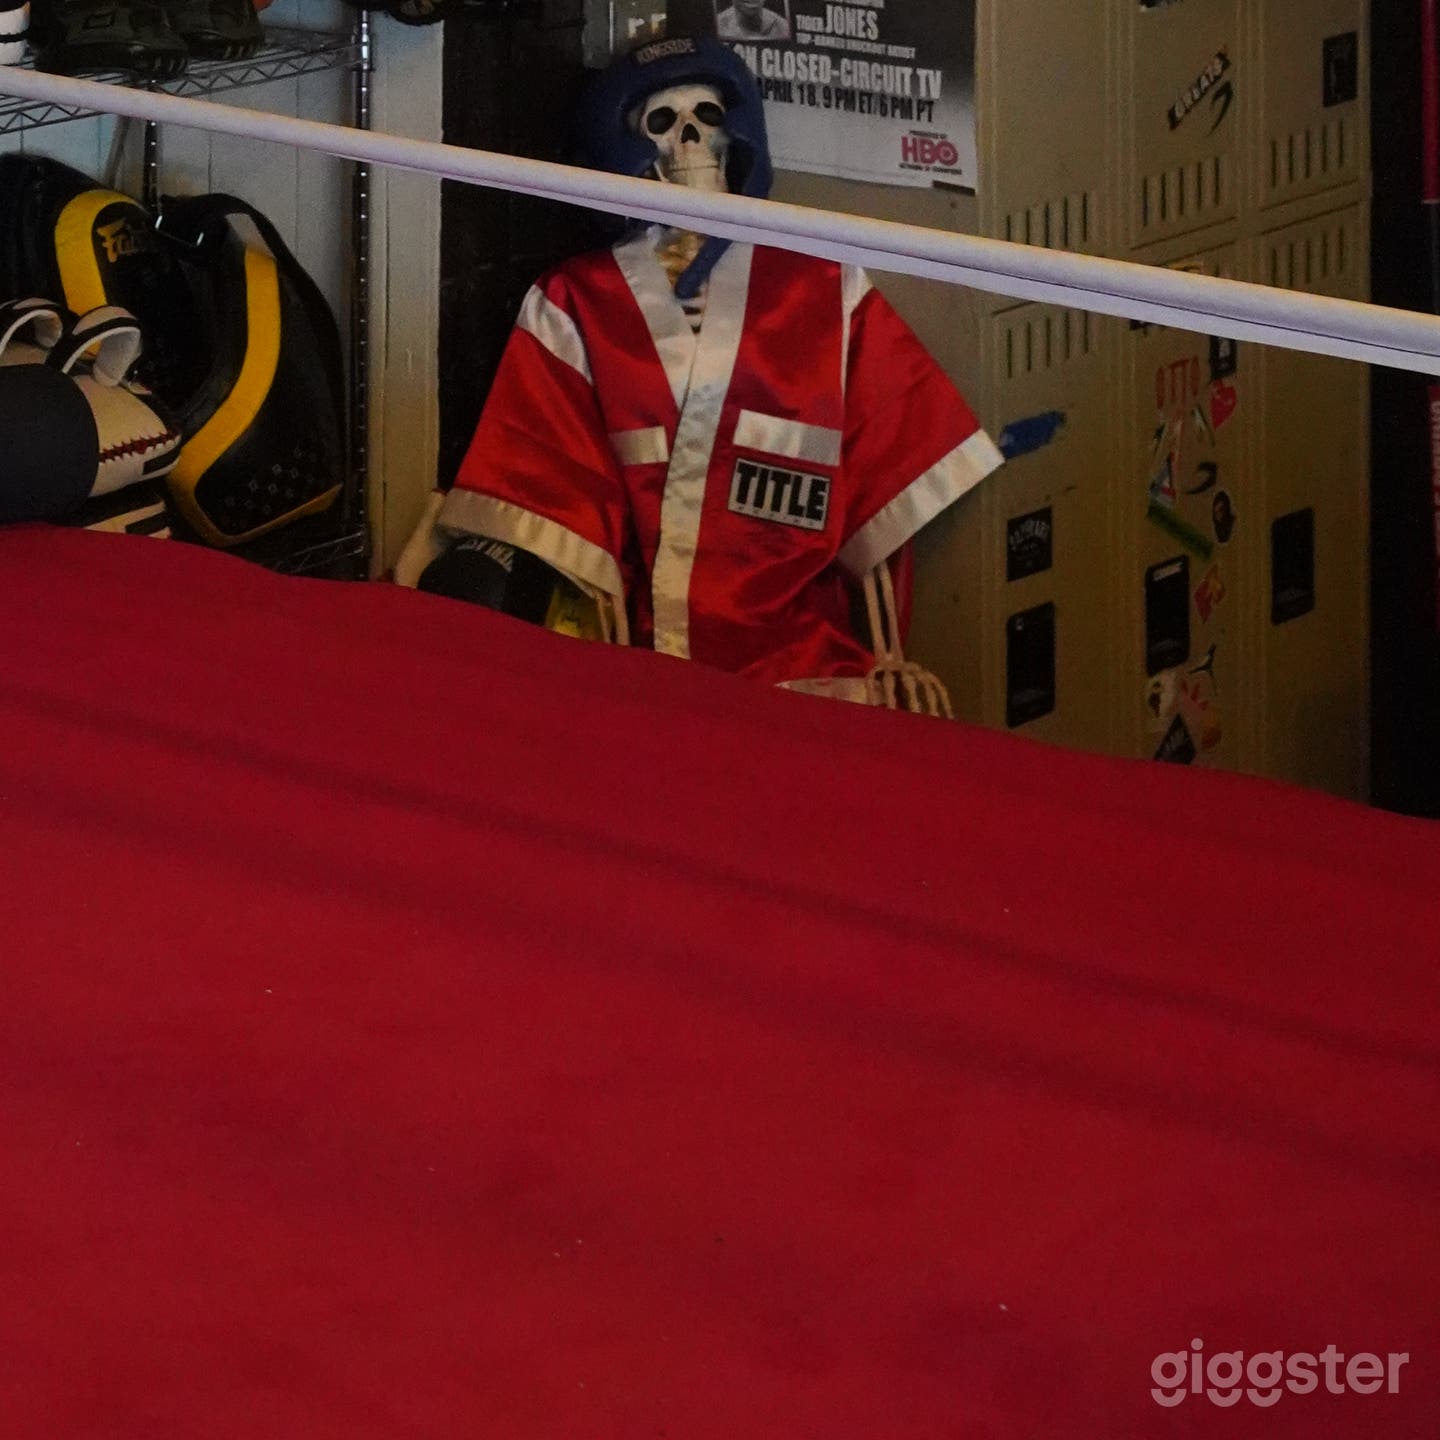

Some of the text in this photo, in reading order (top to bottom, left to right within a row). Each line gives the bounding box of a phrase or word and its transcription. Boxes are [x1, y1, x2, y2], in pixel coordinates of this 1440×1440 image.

[824, 3, 879, 41] JONES
[760, 46, 913, 98] CLOSED-CIRCUIT
[915, 66, 943, 101] TV
[901, 134, 959, 167] HBO
[735, 461, 827, 522] TITLE
